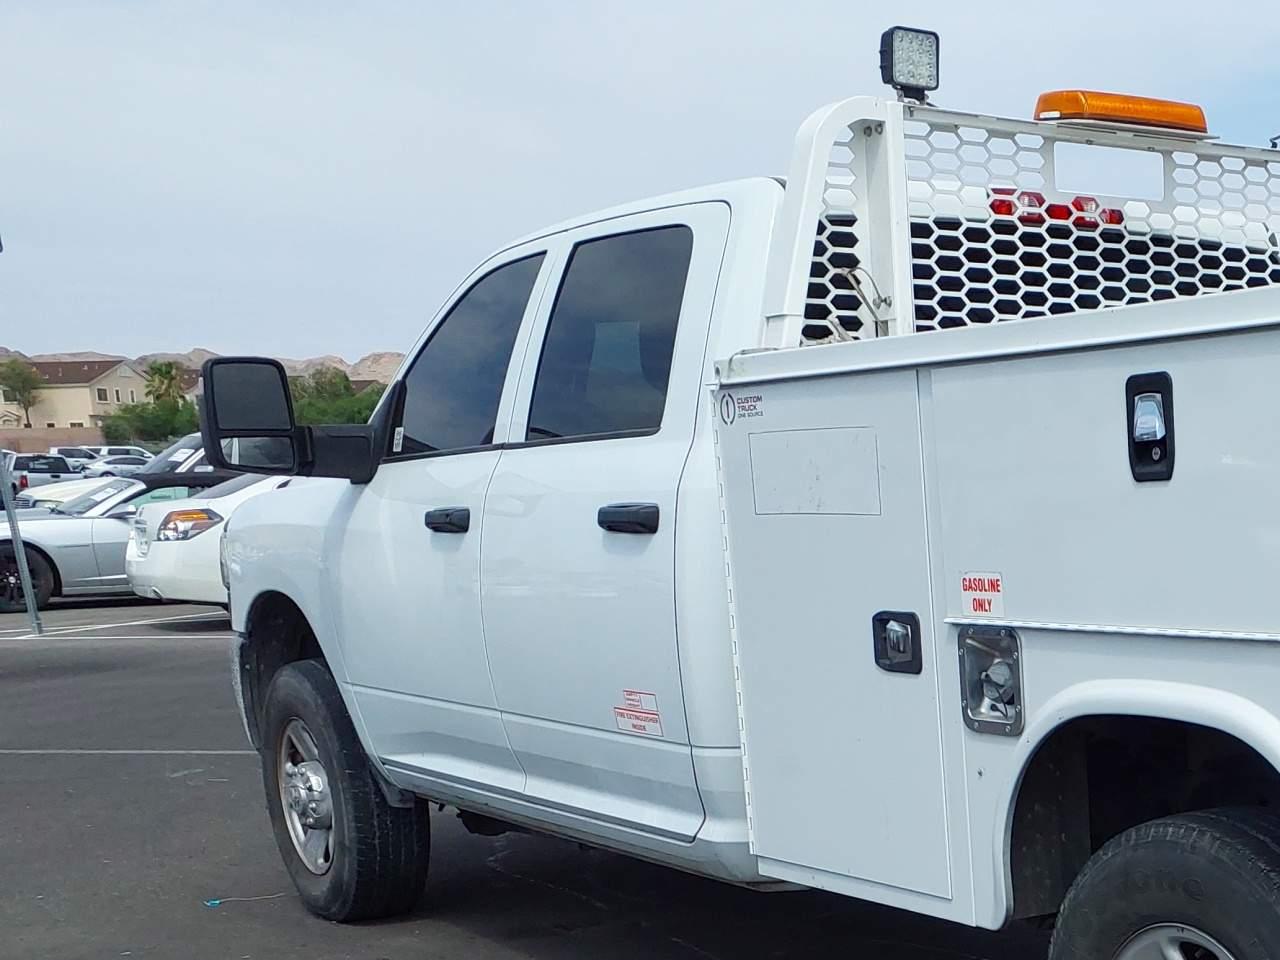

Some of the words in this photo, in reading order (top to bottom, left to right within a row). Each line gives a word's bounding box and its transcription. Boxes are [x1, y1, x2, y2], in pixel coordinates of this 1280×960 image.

[737, 395, 763, 404] CUSTOM
[737, 404, 757, 412] TRUCK
[962, 577, 1001, 592] GASOLINE
[972, 597, 992, 612] ONLY
